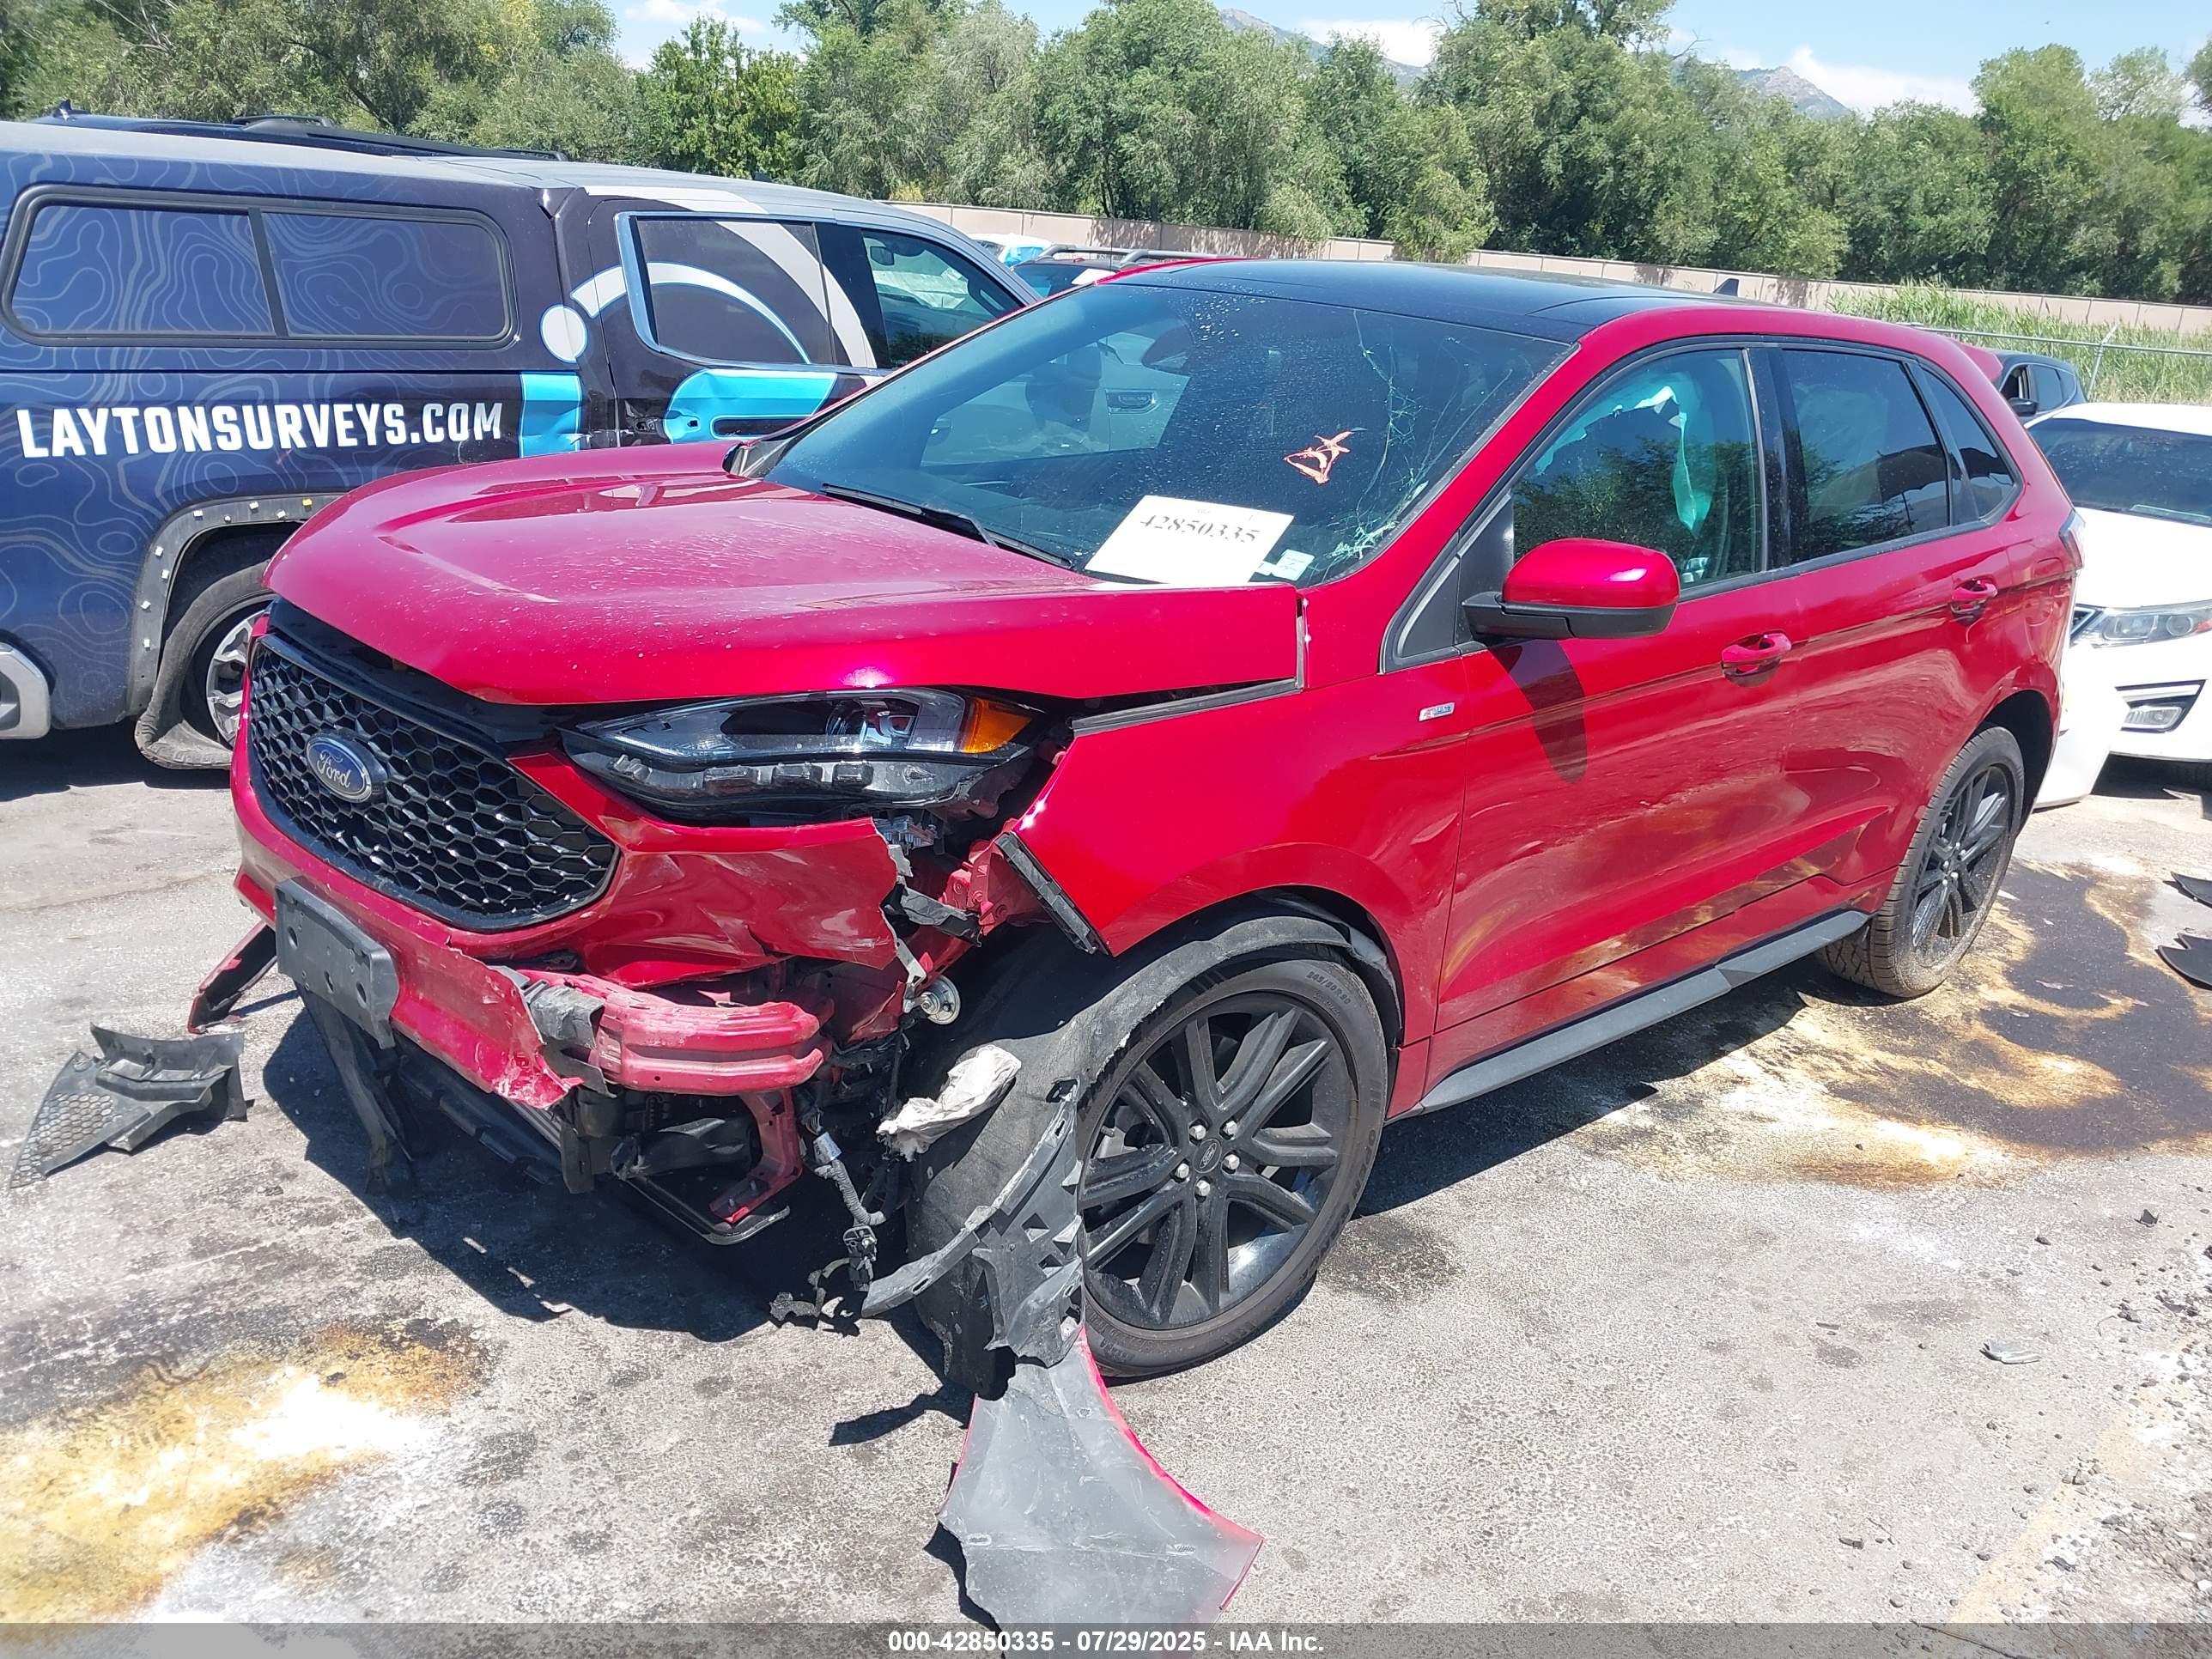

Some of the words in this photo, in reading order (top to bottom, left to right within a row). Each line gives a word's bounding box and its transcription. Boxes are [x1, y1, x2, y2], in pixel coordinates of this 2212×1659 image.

[16, 403, 503, 459] LAYTONSURVEYS.COM
[1140, 515, 1260, 543] 42850335
[317, 749, 351, 788] Ford
